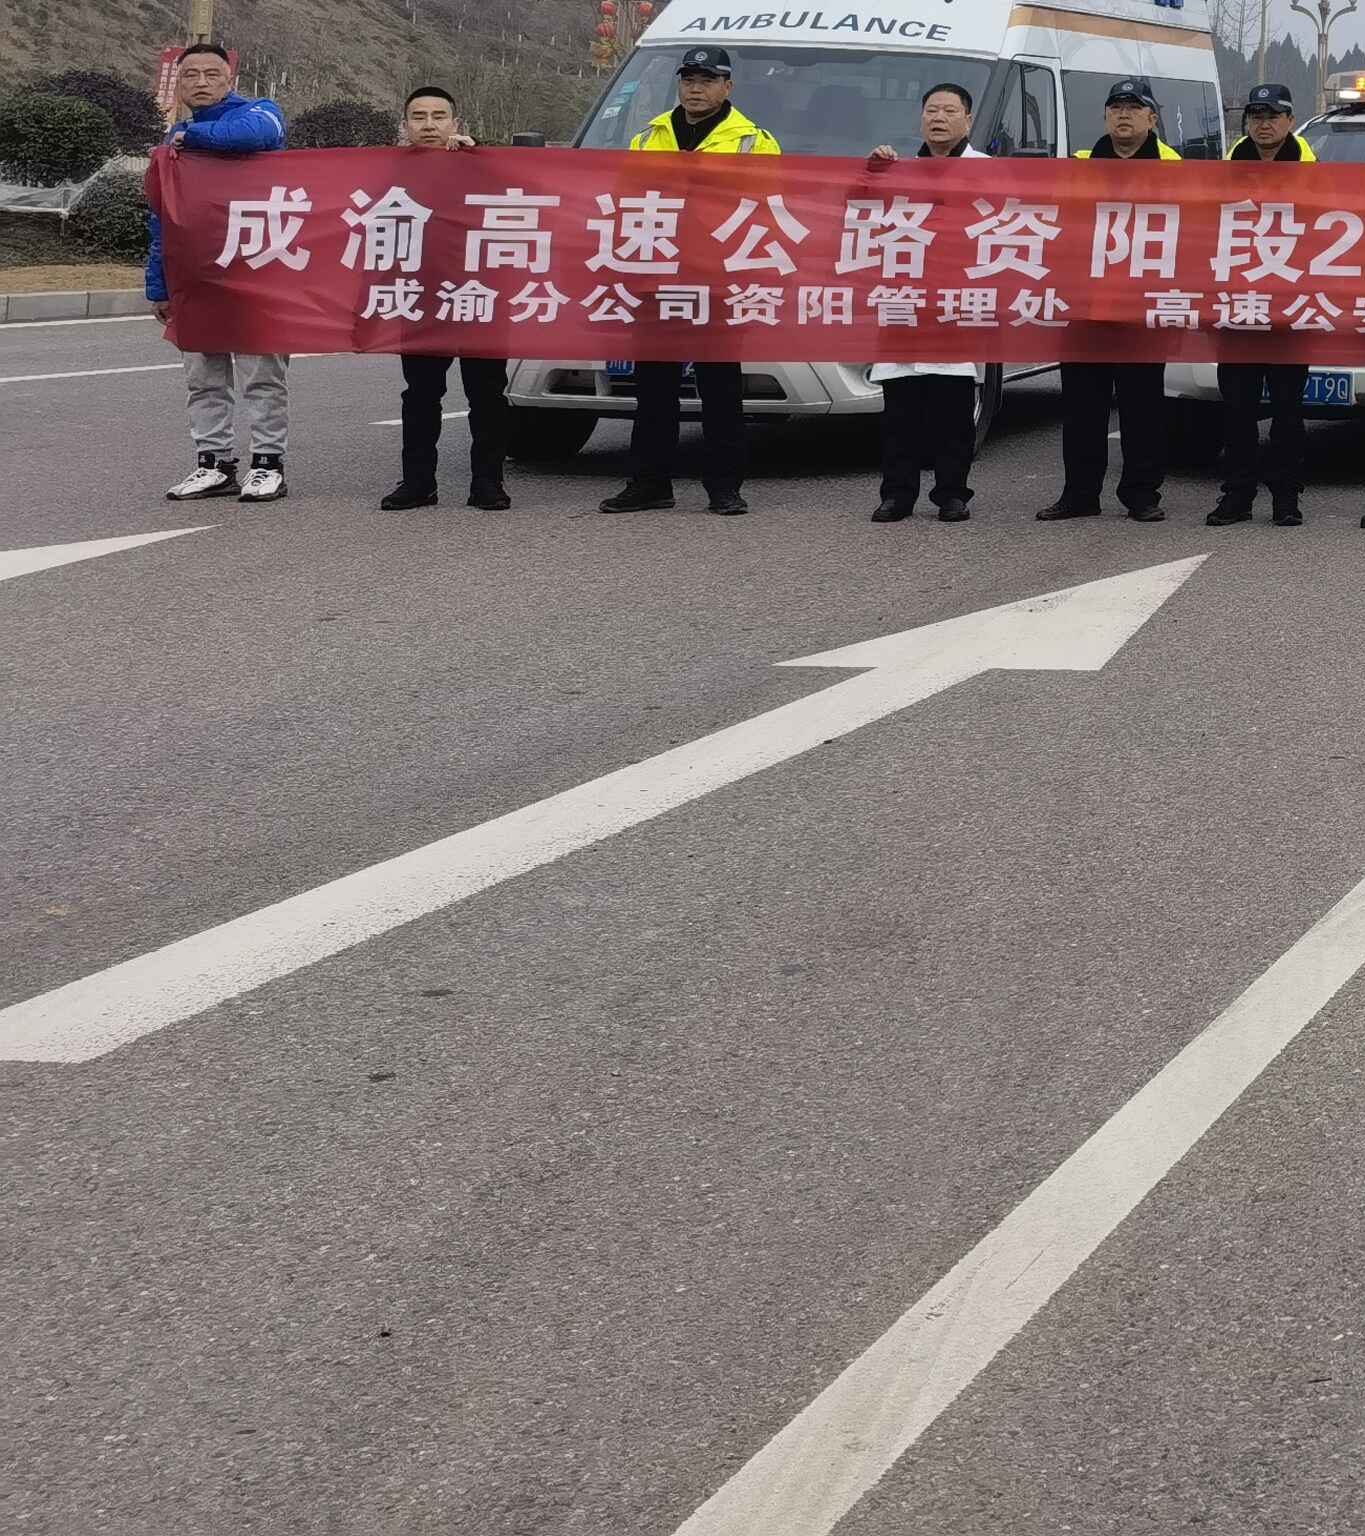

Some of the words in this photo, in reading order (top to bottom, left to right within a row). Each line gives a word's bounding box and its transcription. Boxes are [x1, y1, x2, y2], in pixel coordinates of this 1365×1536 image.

[680, 11, 952, 42] AMBULANCE
[360, 278, 1071, 328] 成渝分公司资阳管理处
